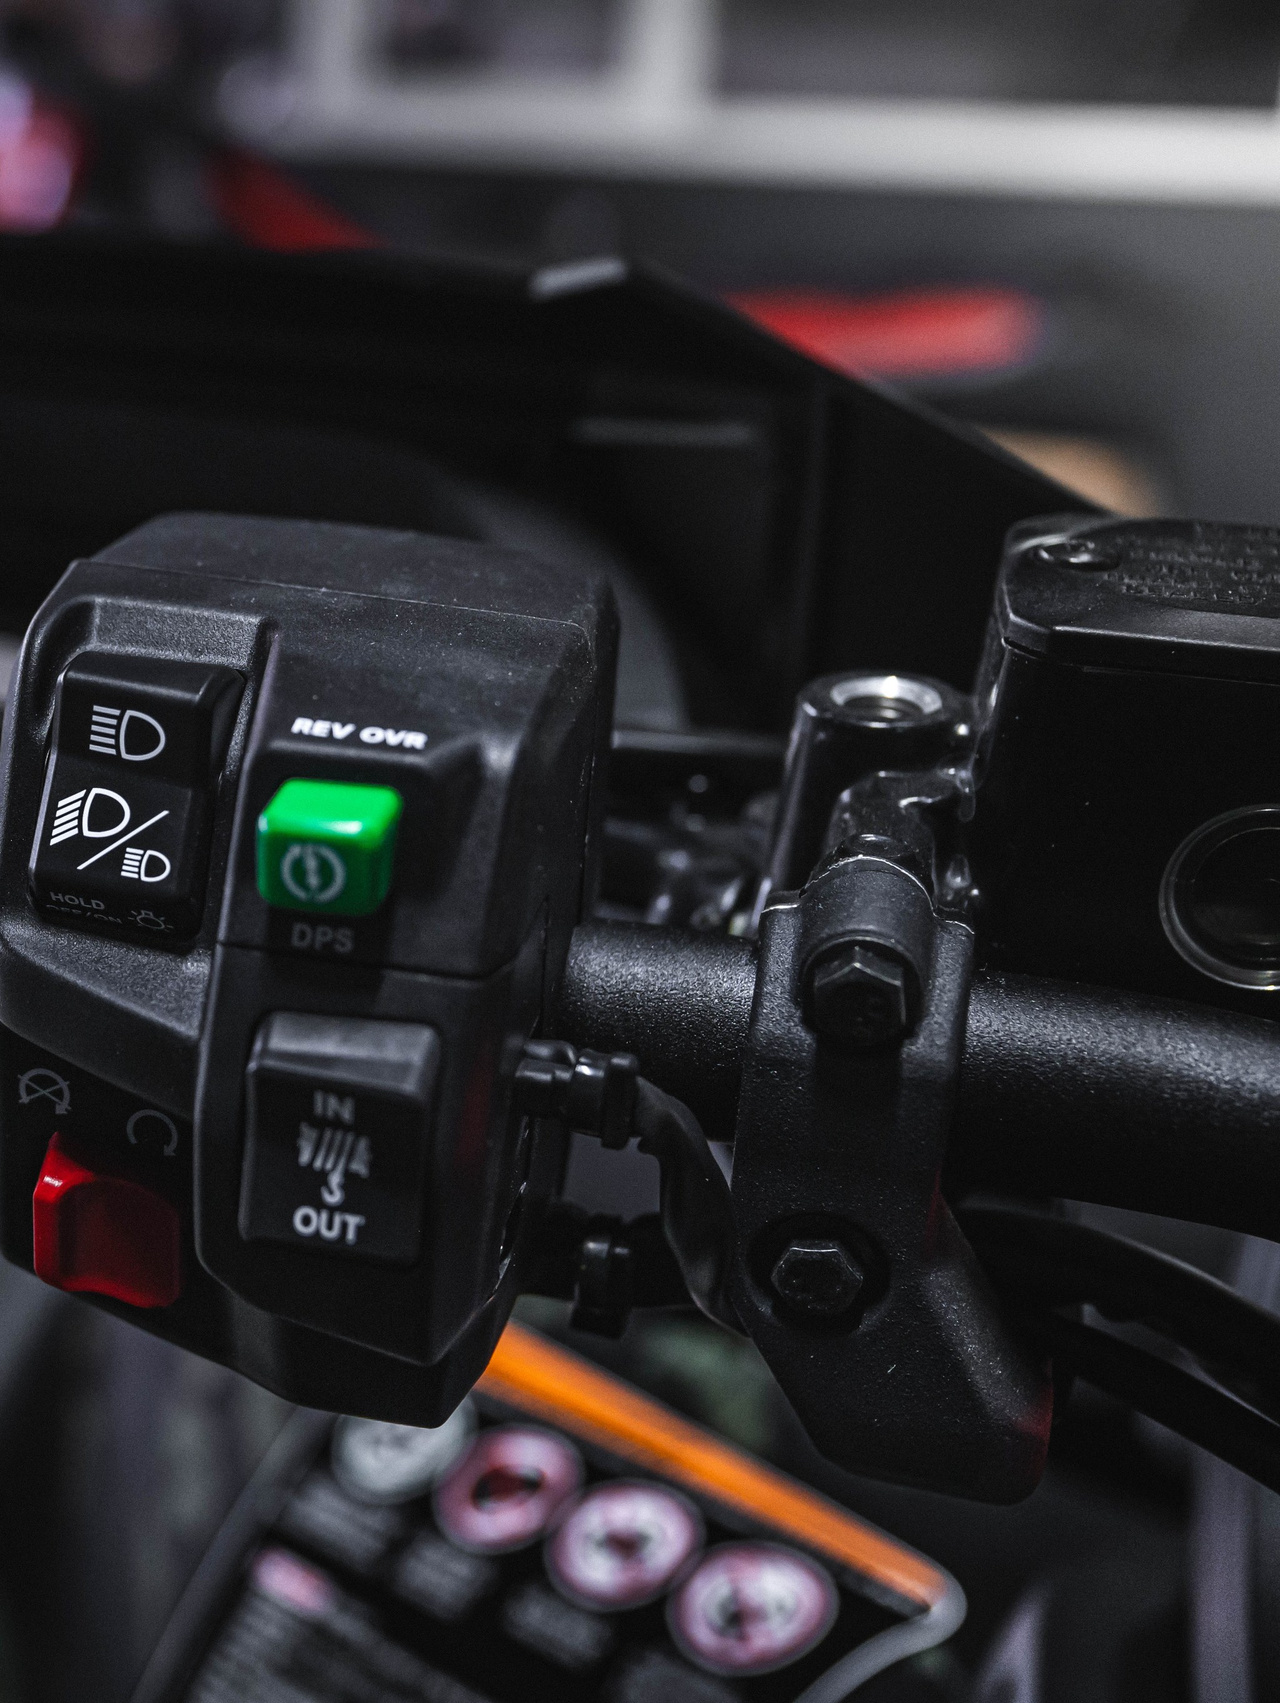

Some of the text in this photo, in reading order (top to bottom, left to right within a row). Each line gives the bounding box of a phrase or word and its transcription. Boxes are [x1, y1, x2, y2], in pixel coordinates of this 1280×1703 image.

[292, 717, 428, 751] REV OVR
[49, 891, 106, 911] HOLD
[292, 923, 355, 953] DPS
[313, 1090, 355, 1122] IN
[293, 1205, 366, 1245] OUT
